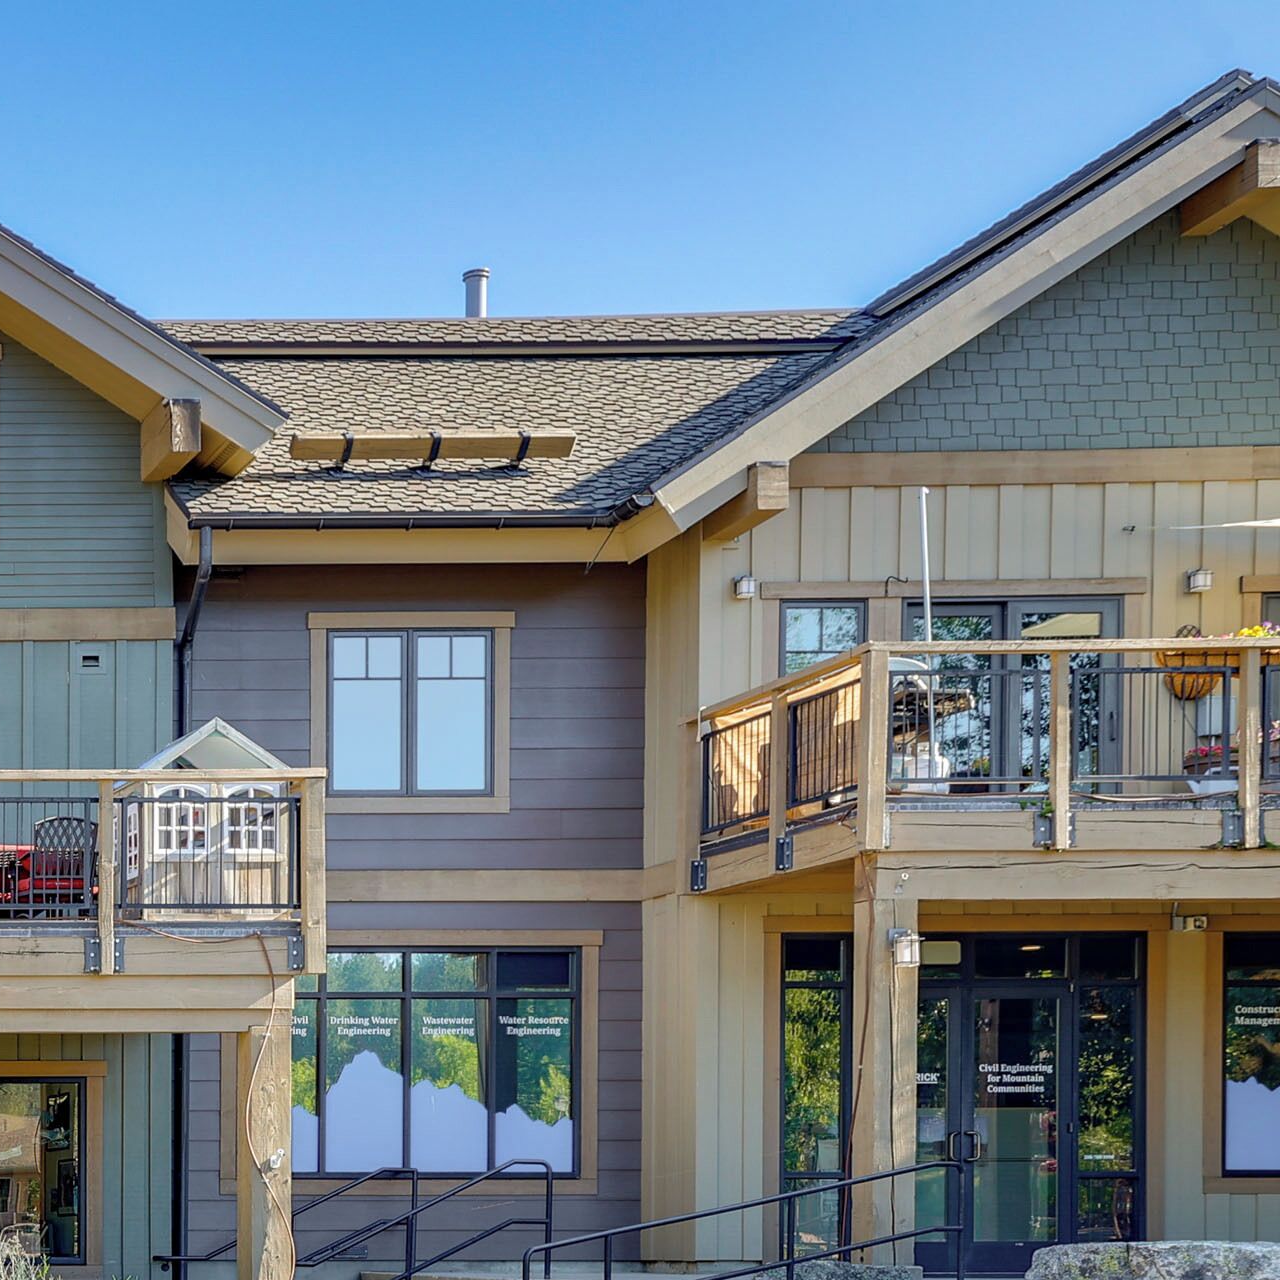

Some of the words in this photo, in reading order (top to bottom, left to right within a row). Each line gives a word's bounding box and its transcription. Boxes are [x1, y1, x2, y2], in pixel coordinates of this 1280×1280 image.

[330, 1016, 370, 1026] Drinking
[371, 1016, 399, 1025] Water
[422, 1016, 474, 1025] Wastewater
[498, 1016, 527, 1025] Water
[528, 1016, 570, 1025] Resource
[337, 1026, 391, 1037] Engineering
[422, 1026, 475, 1036] Engineering
[506, 1026, 561, 1037] Engineering
[979, 1064, 1000, 1073] Civil
[1000, 1064, 1053, 1074] Engineering
[987, 1074, 1001, 1083] for
[1002, 1074, 1045, 1083] Mountain
[986, 1084, 1045, 1093] Communities
